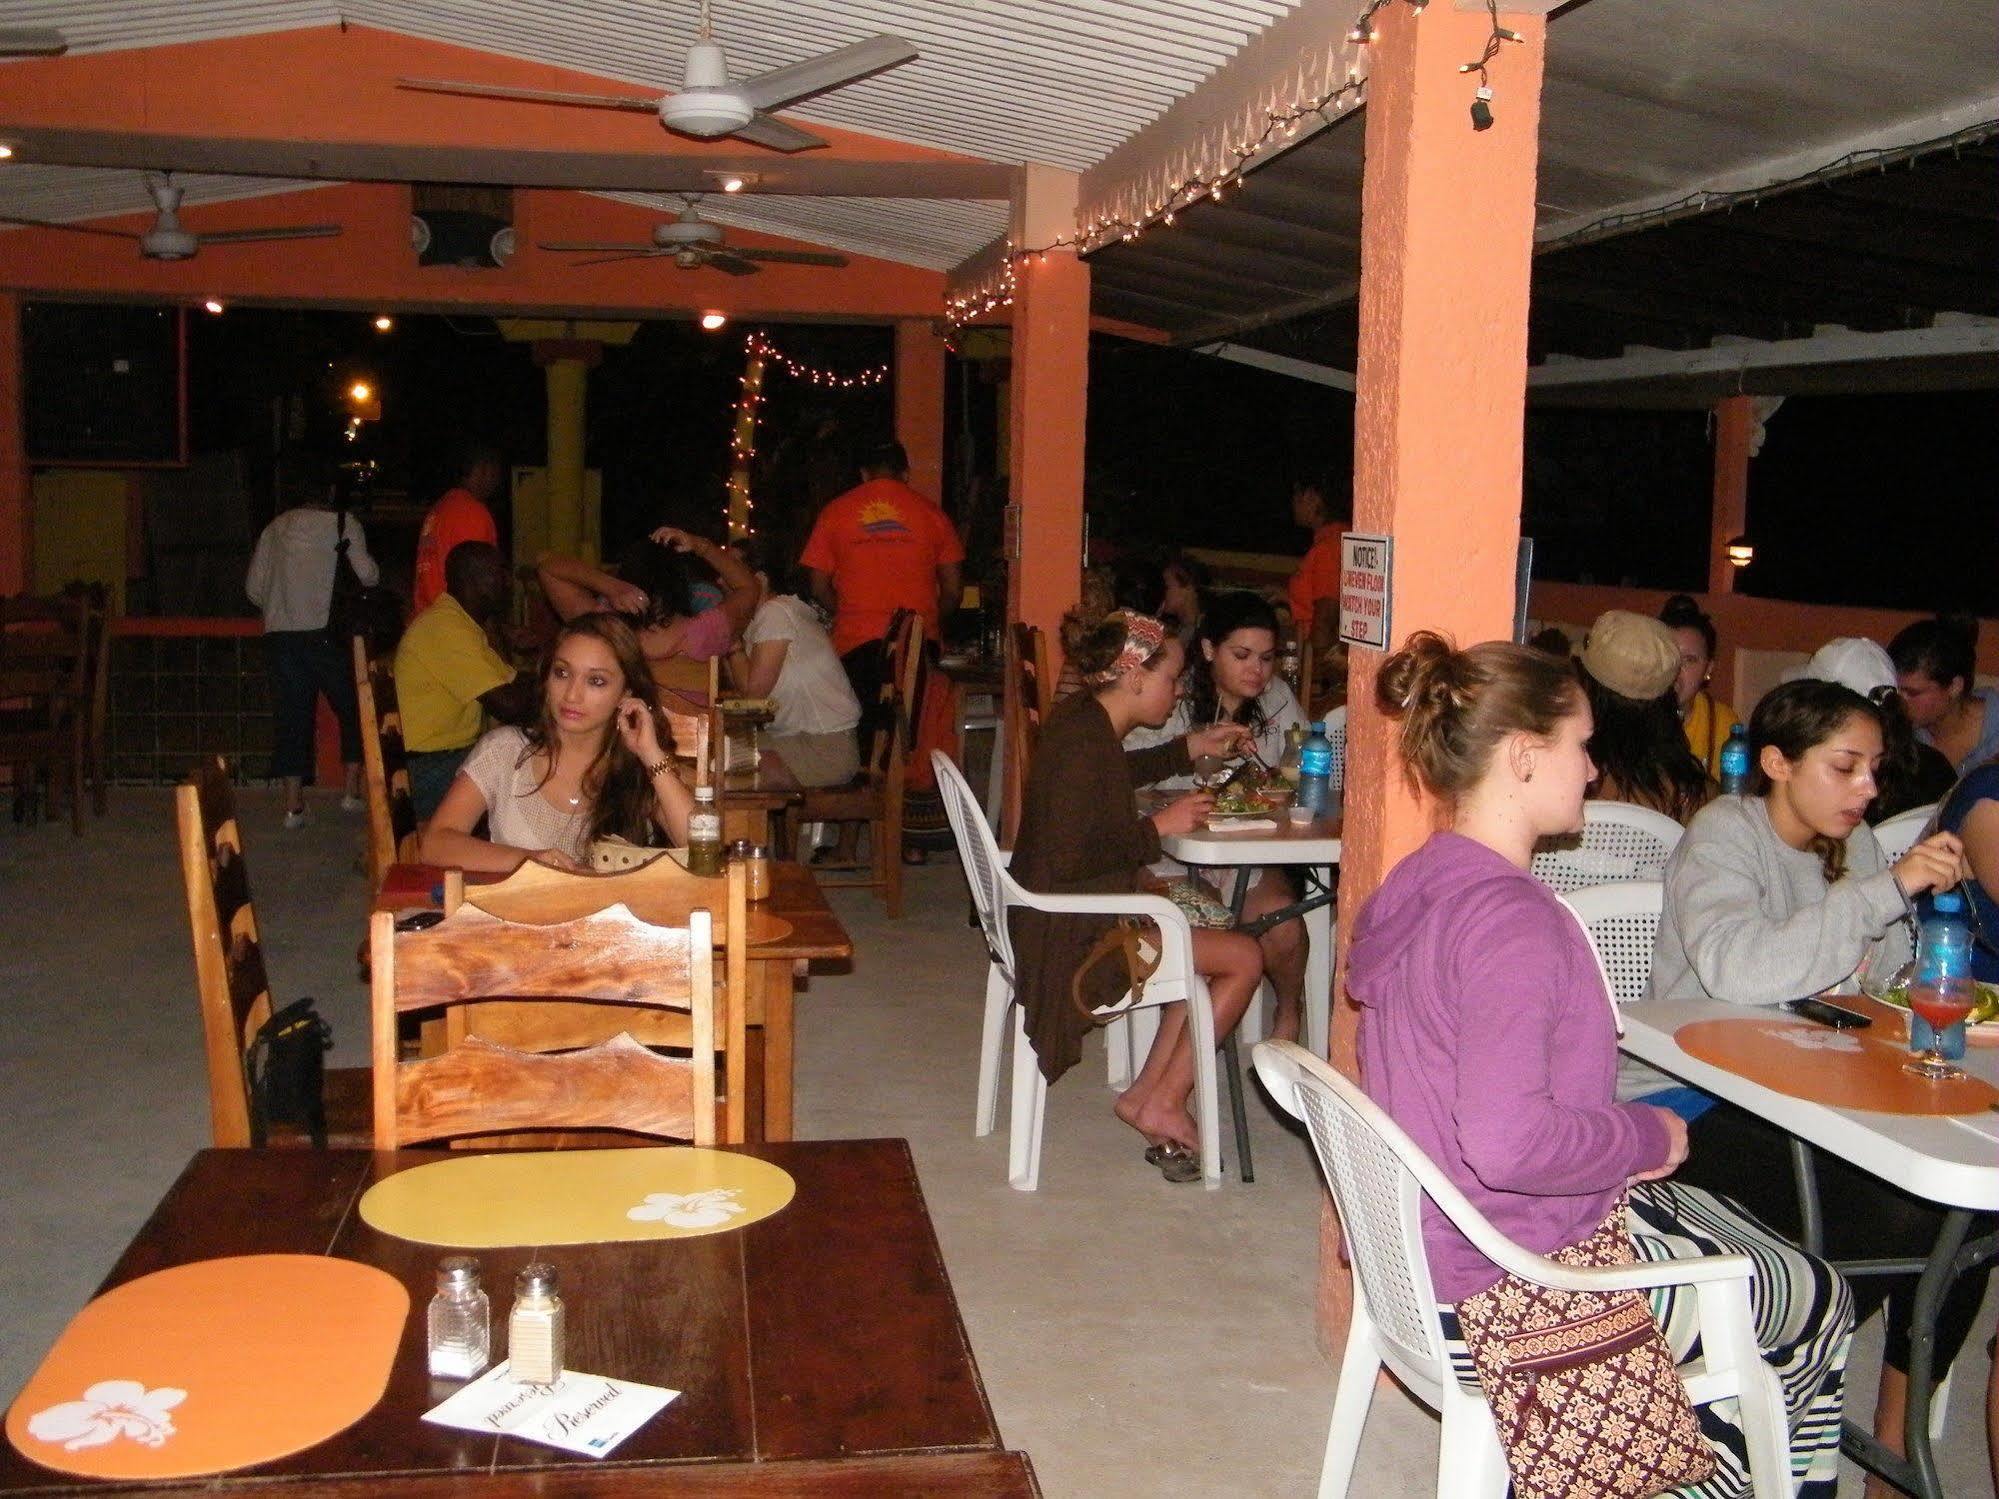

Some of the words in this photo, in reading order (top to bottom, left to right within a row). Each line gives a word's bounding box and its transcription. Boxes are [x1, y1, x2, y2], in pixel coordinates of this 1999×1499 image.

[1366, 573, 1385, 592] FLOOR
[1343, 594, 1363, 615] WATCH
[1364, 597, 1381, 617] YOUR
[1351, 619, 1368, 639] STEP
[542, 1382, 623, 1441] Reserved
